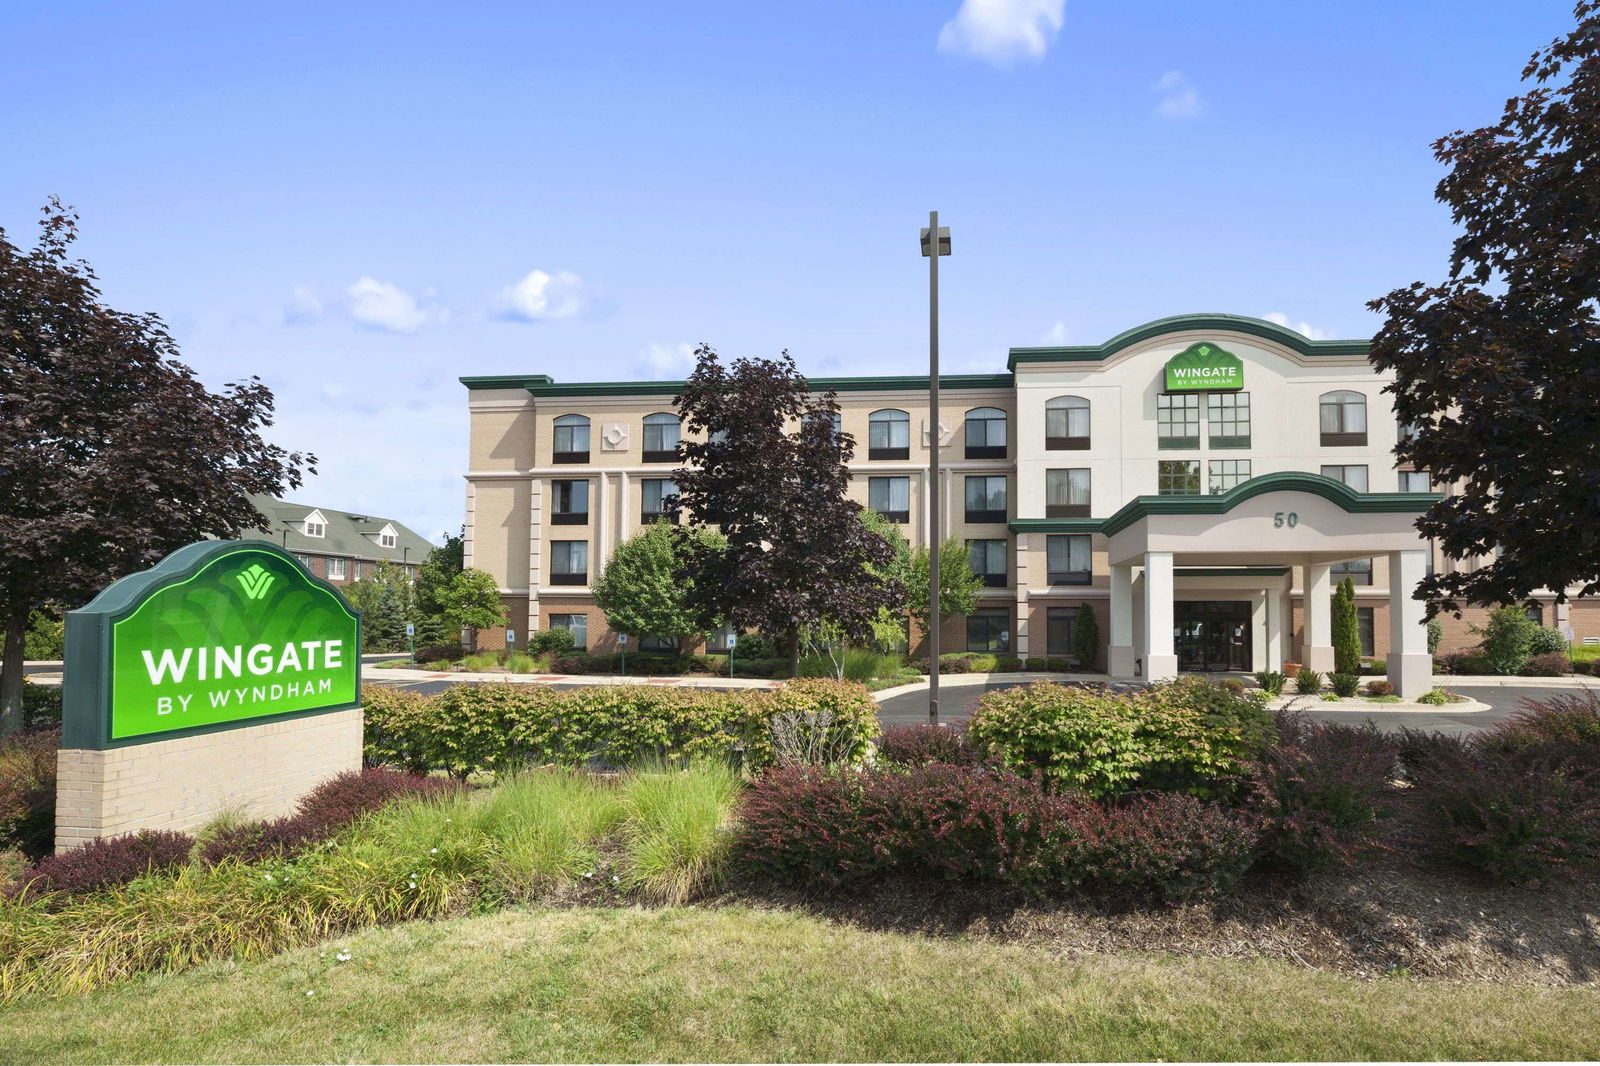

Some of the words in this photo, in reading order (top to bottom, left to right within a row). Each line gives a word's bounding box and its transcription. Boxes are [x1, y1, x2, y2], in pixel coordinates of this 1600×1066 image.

[1173, 367, 1236, 378] WINGATE
[1274, 512, 1298, 528] 50
[141, 639, 342, 685] WINGATE
[156, 694, 193, 715] BY
[208, 678, 332, 708] WYNDHAM
